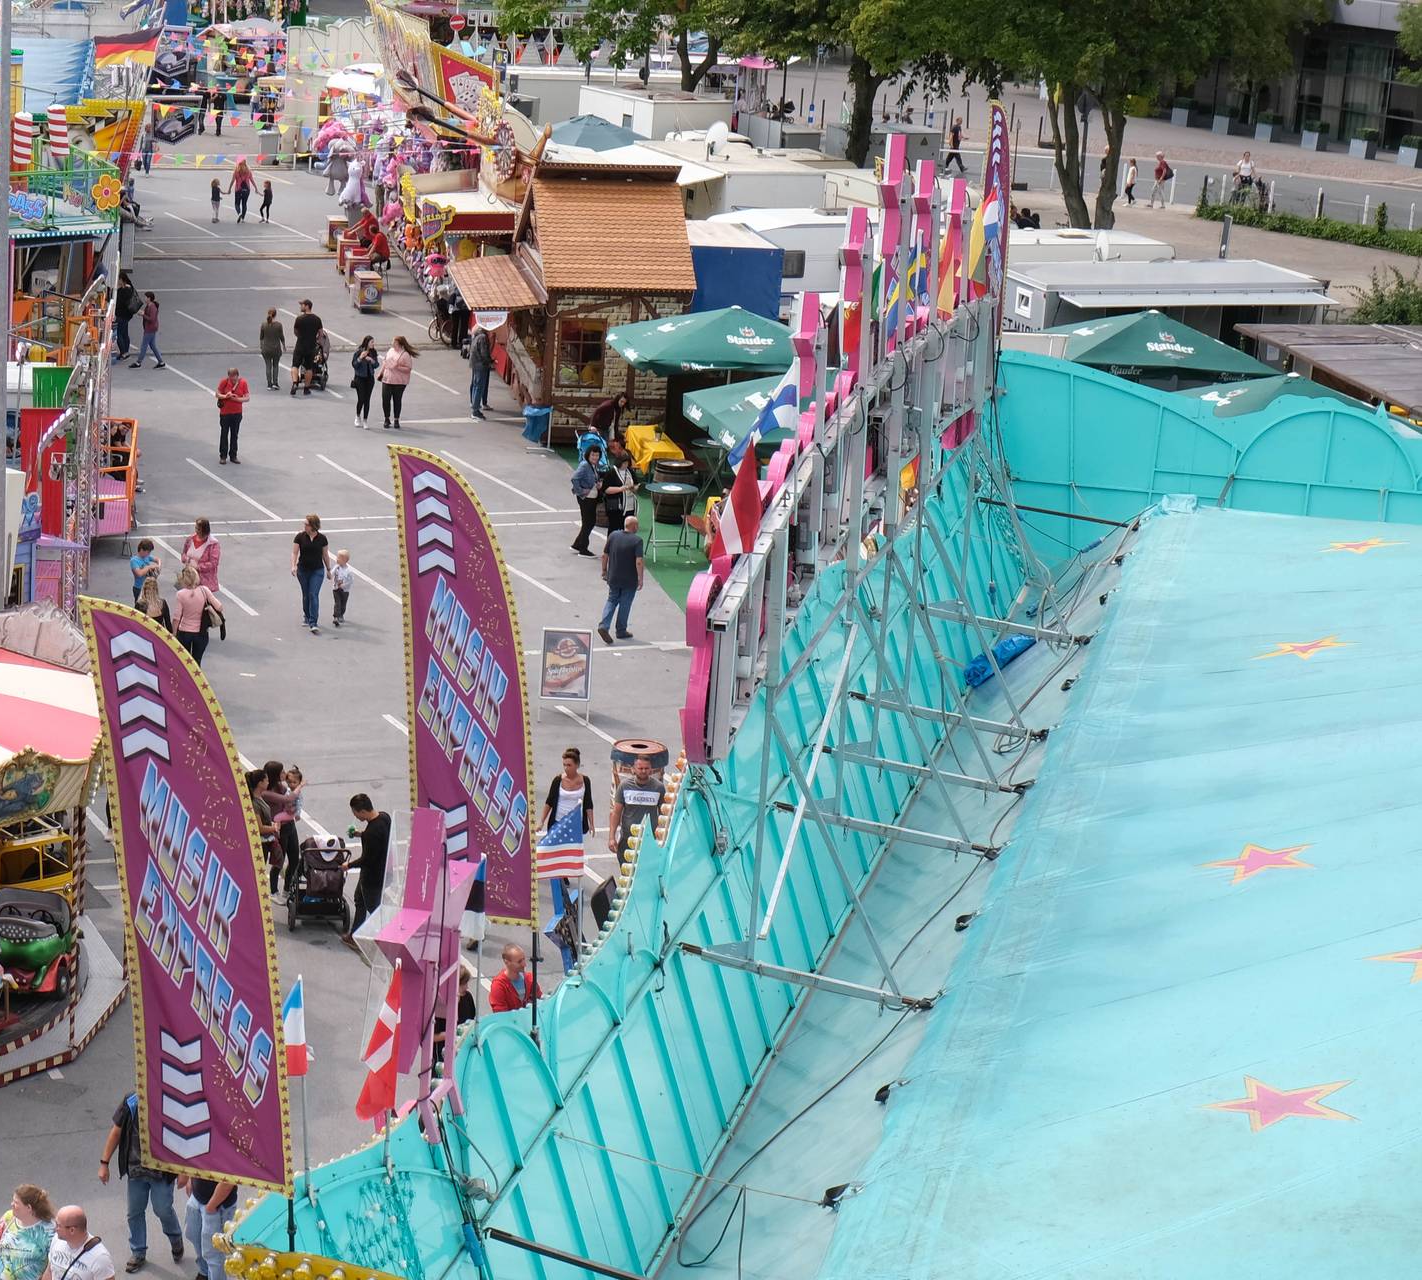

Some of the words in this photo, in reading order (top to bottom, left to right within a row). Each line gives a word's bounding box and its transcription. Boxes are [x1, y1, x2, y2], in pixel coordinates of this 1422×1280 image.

[726, 334, 775, 345] Stauder
[1108, 364, 1143, 376] Stauder
[1146, 341, 1195, 354] Stauder
[424, 572, 509, 738] MUSIK
[417, 653, 529, 858] EXPRESS
[139, 757, 242, 963] MUSIK
[133, 857, 274, 1108] EXPRESS
